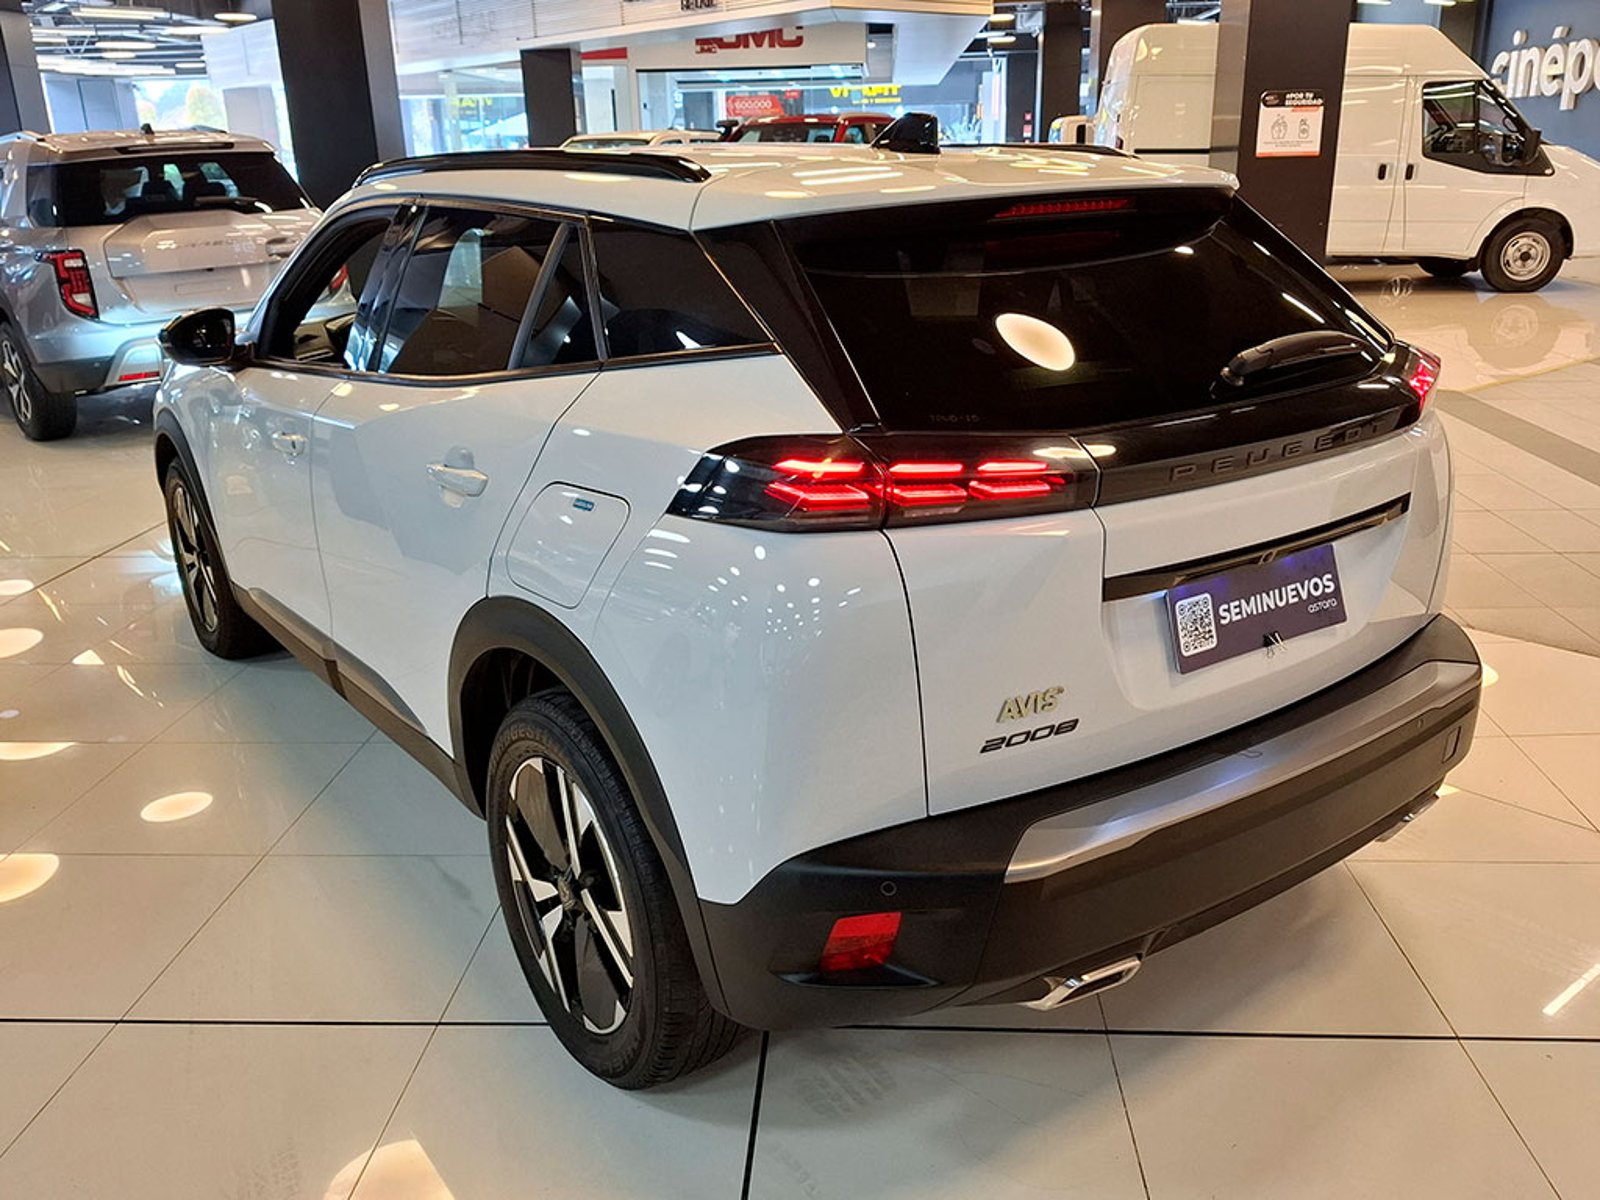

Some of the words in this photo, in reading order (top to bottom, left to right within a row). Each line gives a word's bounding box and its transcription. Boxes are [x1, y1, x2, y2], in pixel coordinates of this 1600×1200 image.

[1491, 26, 1600, 110] cinép
[1168, 419, 1388, 481] PEUGEOT
[1219, 573, 1335, 625] SEMINUEVOS
[996, 687, 1062, 723] AVIS
[980, 718, 1079, 754] 2008
